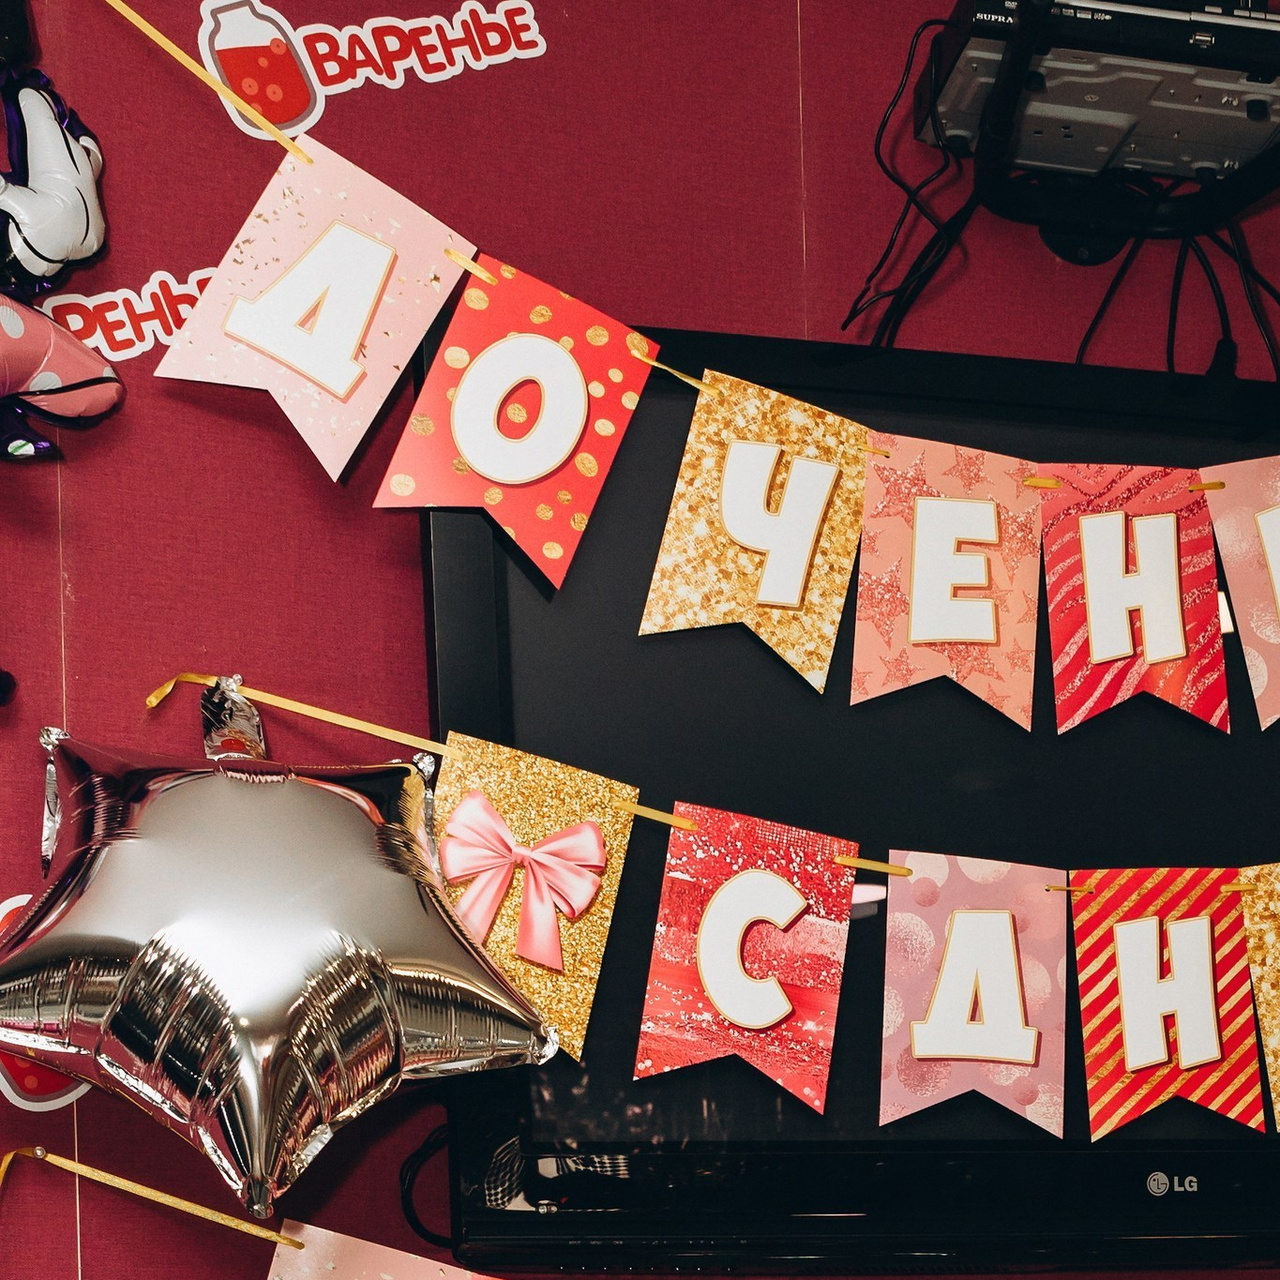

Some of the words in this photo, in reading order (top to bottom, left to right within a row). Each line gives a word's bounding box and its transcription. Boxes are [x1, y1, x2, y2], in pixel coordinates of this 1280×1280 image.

[975, 12, 1014, 24] SUPRA
[305, 7, 537, 86] ВАРЕНЬЕ
[696, 867, 809, 1030] С
[1173, 1175, 1198, 1192] LG
